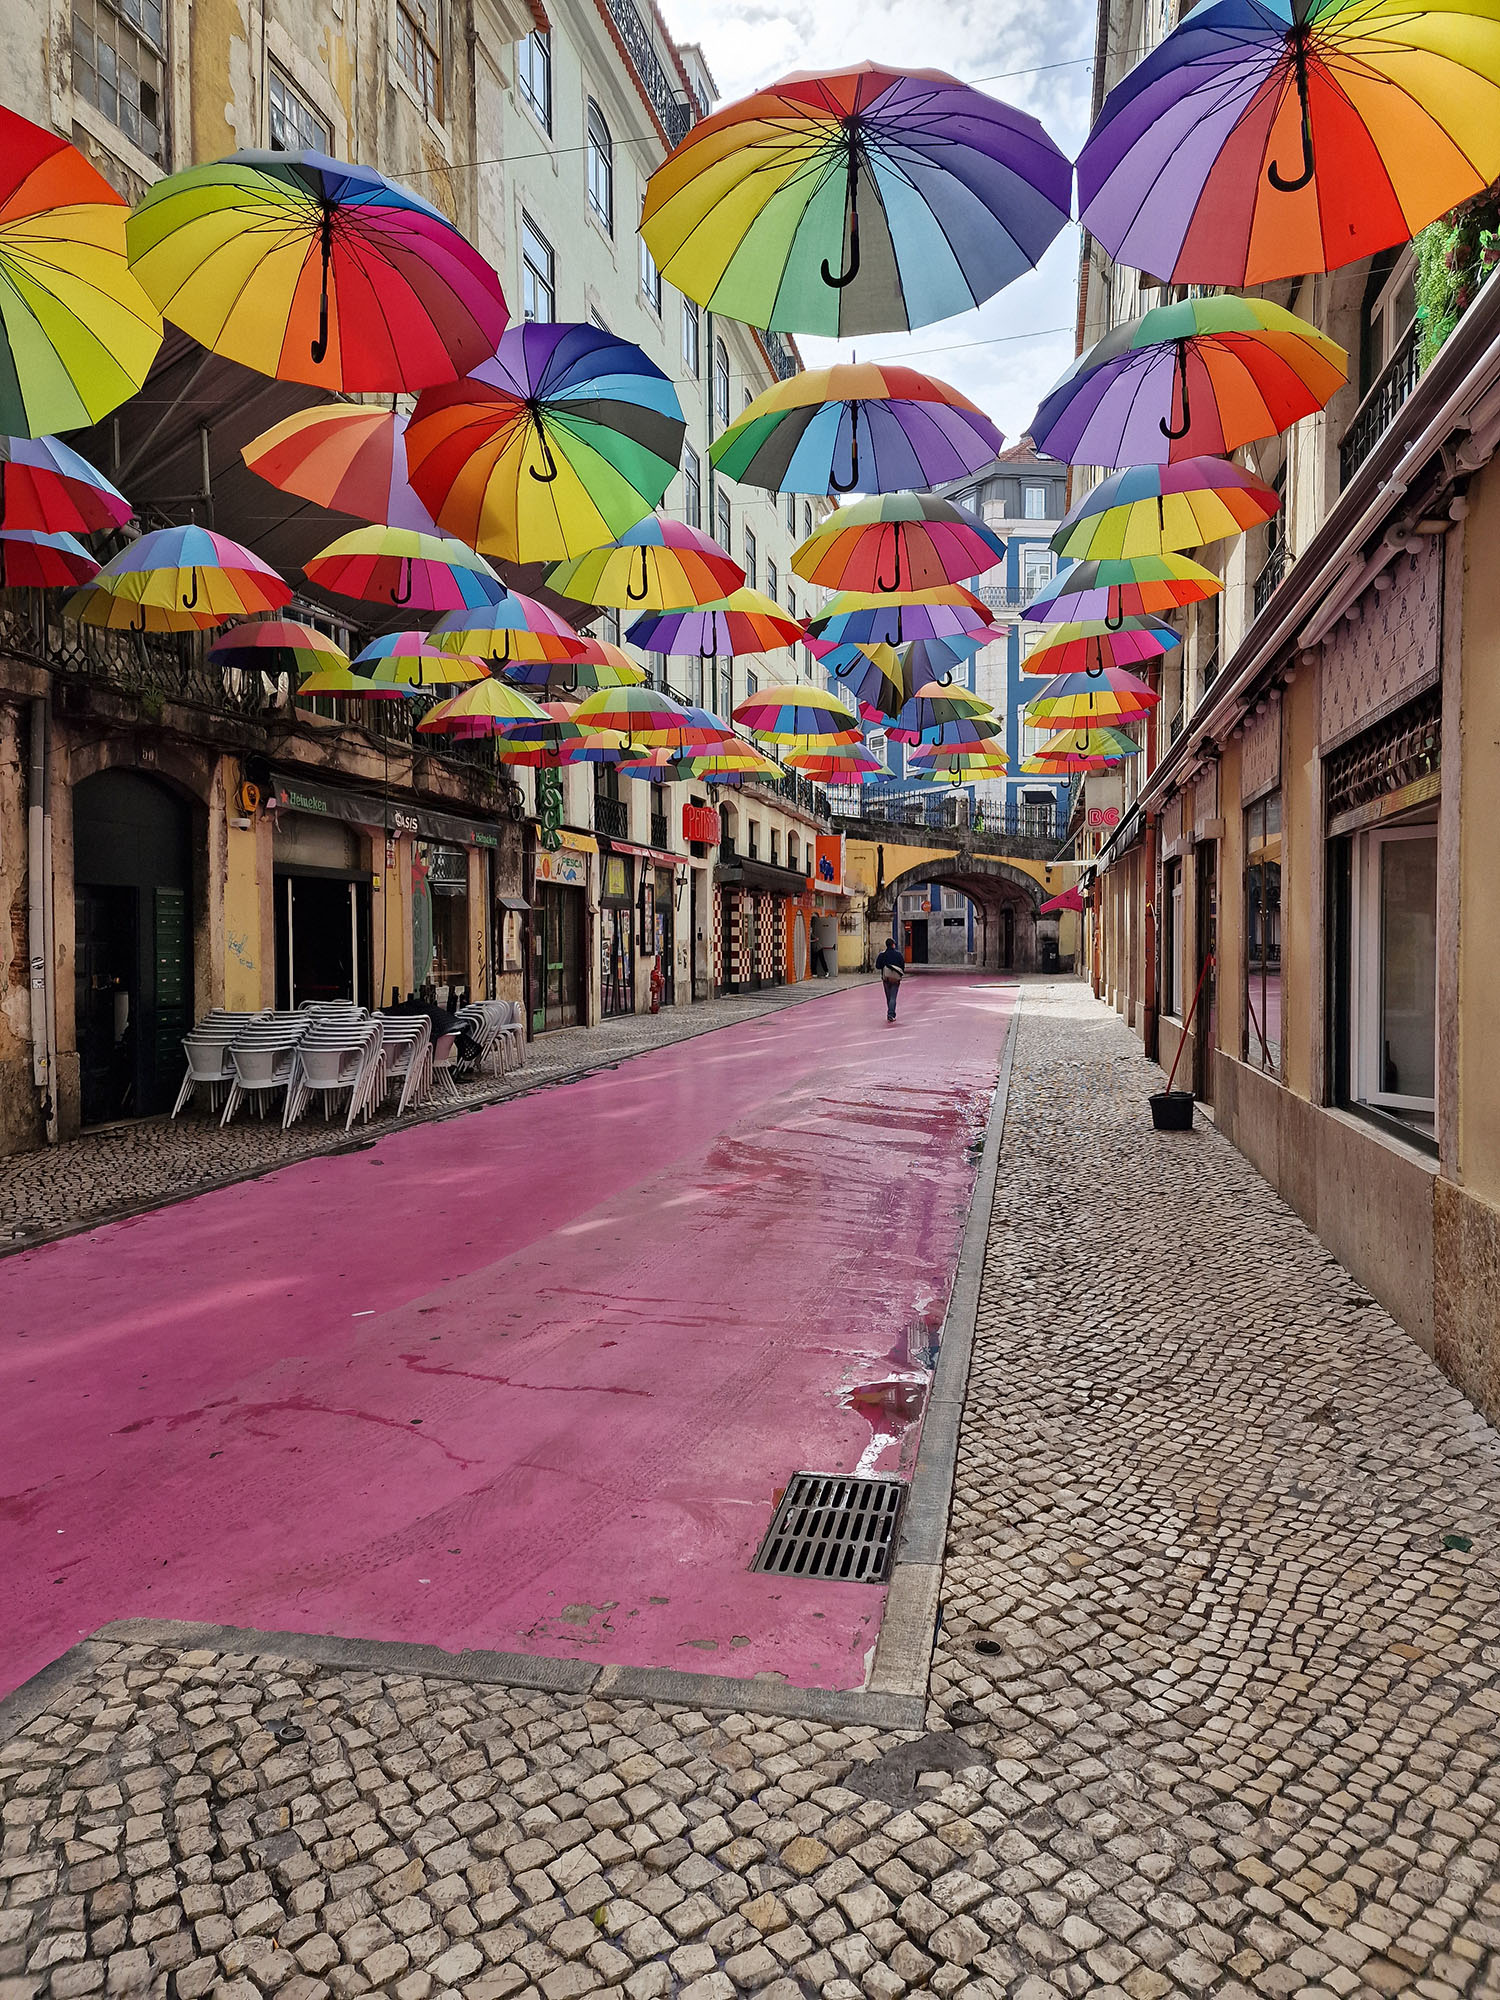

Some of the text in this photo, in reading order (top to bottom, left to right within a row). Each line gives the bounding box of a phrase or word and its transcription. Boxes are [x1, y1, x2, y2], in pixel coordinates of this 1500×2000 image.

[290, 792, 328, 812] Heineken
[395, 812, 418, 830] OASIS
[1088, 807, 1120, 826] BC
[562, 857, 583, 869] PESCA
